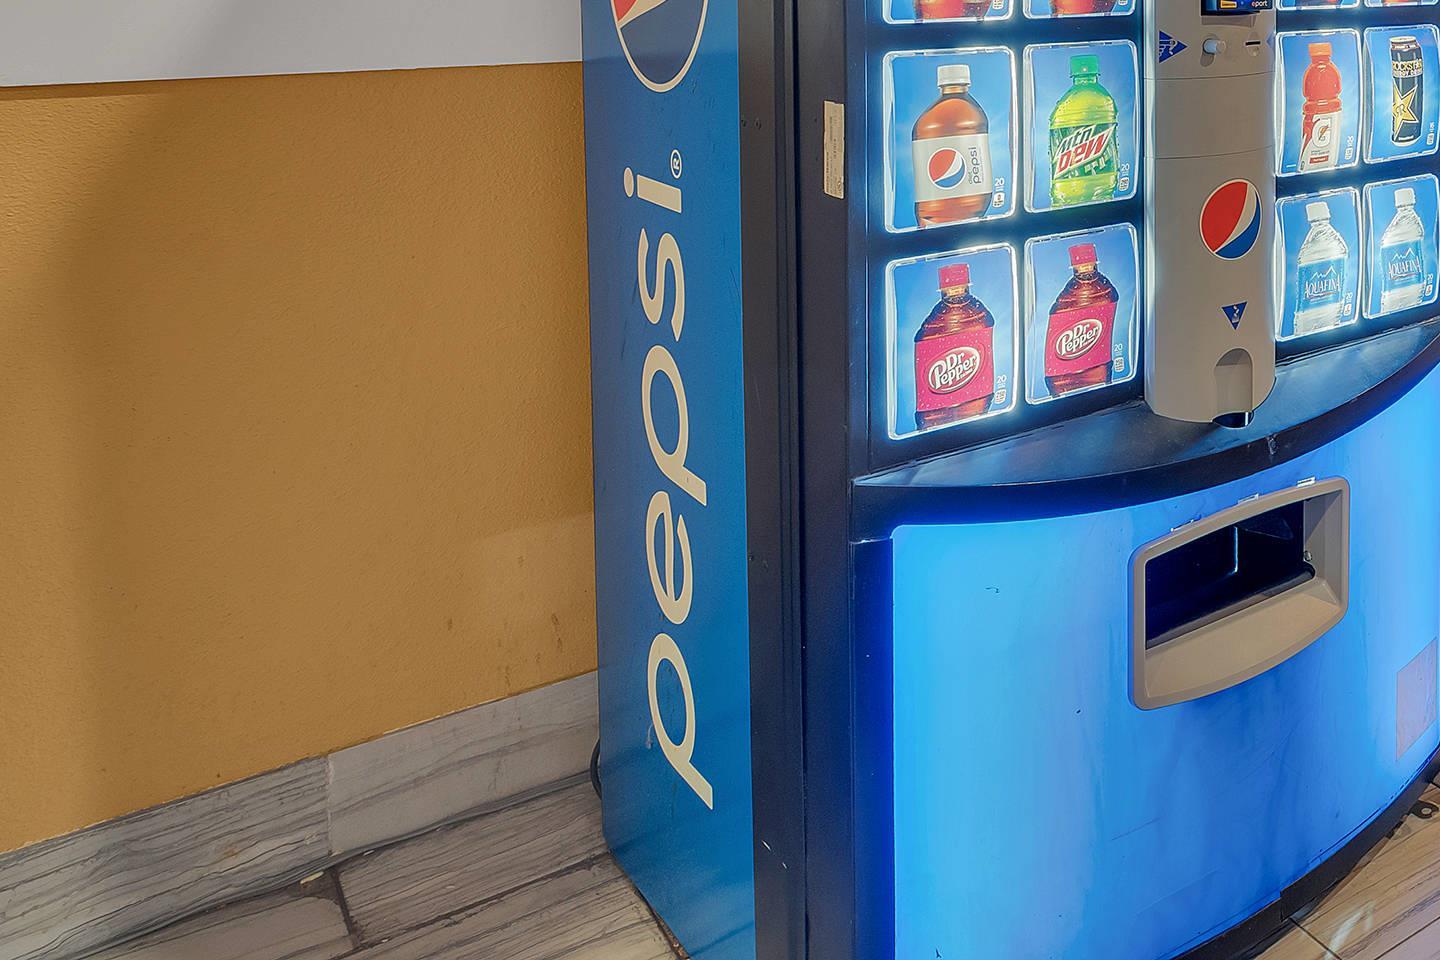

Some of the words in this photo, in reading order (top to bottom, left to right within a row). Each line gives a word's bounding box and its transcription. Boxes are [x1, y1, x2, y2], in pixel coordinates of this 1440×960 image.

[1251, 0, 1268, 8] eport
[968, 146, 982, 184] pepsi
[994, 177, 1005, 186] 20
[1388, 256, 1421, 278] AQUAFINA
[1305, 274, 1341, 297] AQUAFINA
[1059, 326, 1099, 356] Pepper
[1073, 323, 1091, 340] Dr
[1113, 343, 1123, 352] 20
[945, 352, 965, 371] Dr
[931, 355, 978, 389] Pepper
[996, 374, 1007, 384] 20
[623, 167, 713, 810] pepsi
